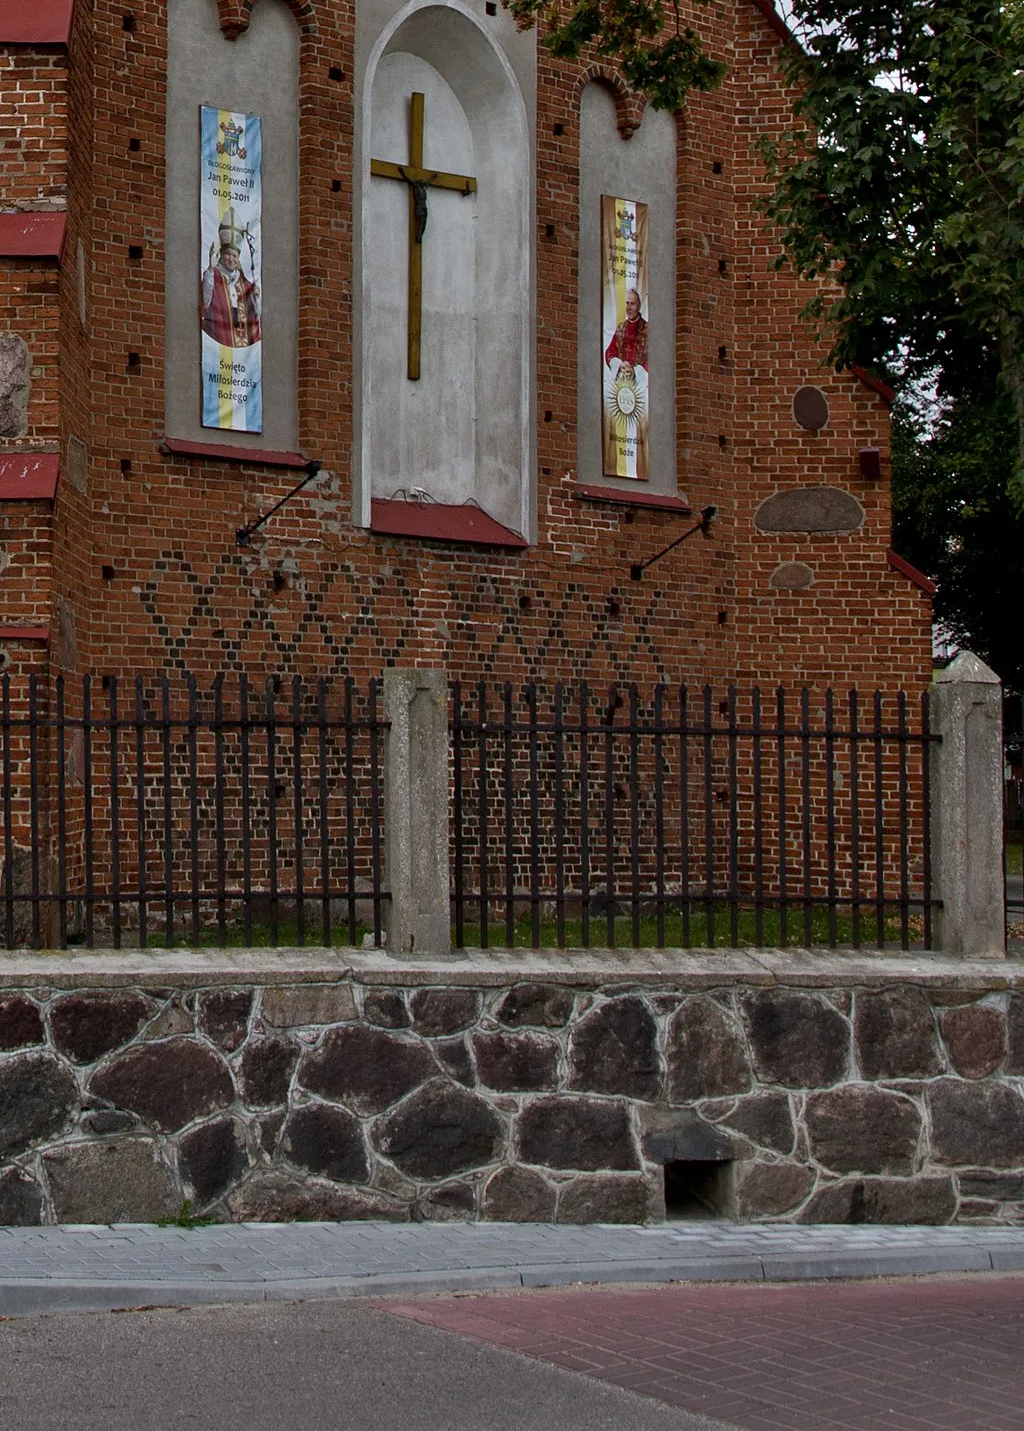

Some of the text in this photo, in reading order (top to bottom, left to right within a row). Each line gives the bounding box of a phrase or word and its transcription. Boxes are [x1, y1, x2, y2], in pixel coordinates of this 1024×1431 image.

[207, 160, 255, 175] BŁOGOSŁAWIONY
[208, 171, 255, 189] Jan Paweł II
[212, 189, 250, 203] 01.05.2011
[219, 358, 246, 374] Święto
[208, 373, 257, 389] Miłosierdzia
[217, 389, 248, 404] Bożego
[618, 447, 635, 457] Boże
